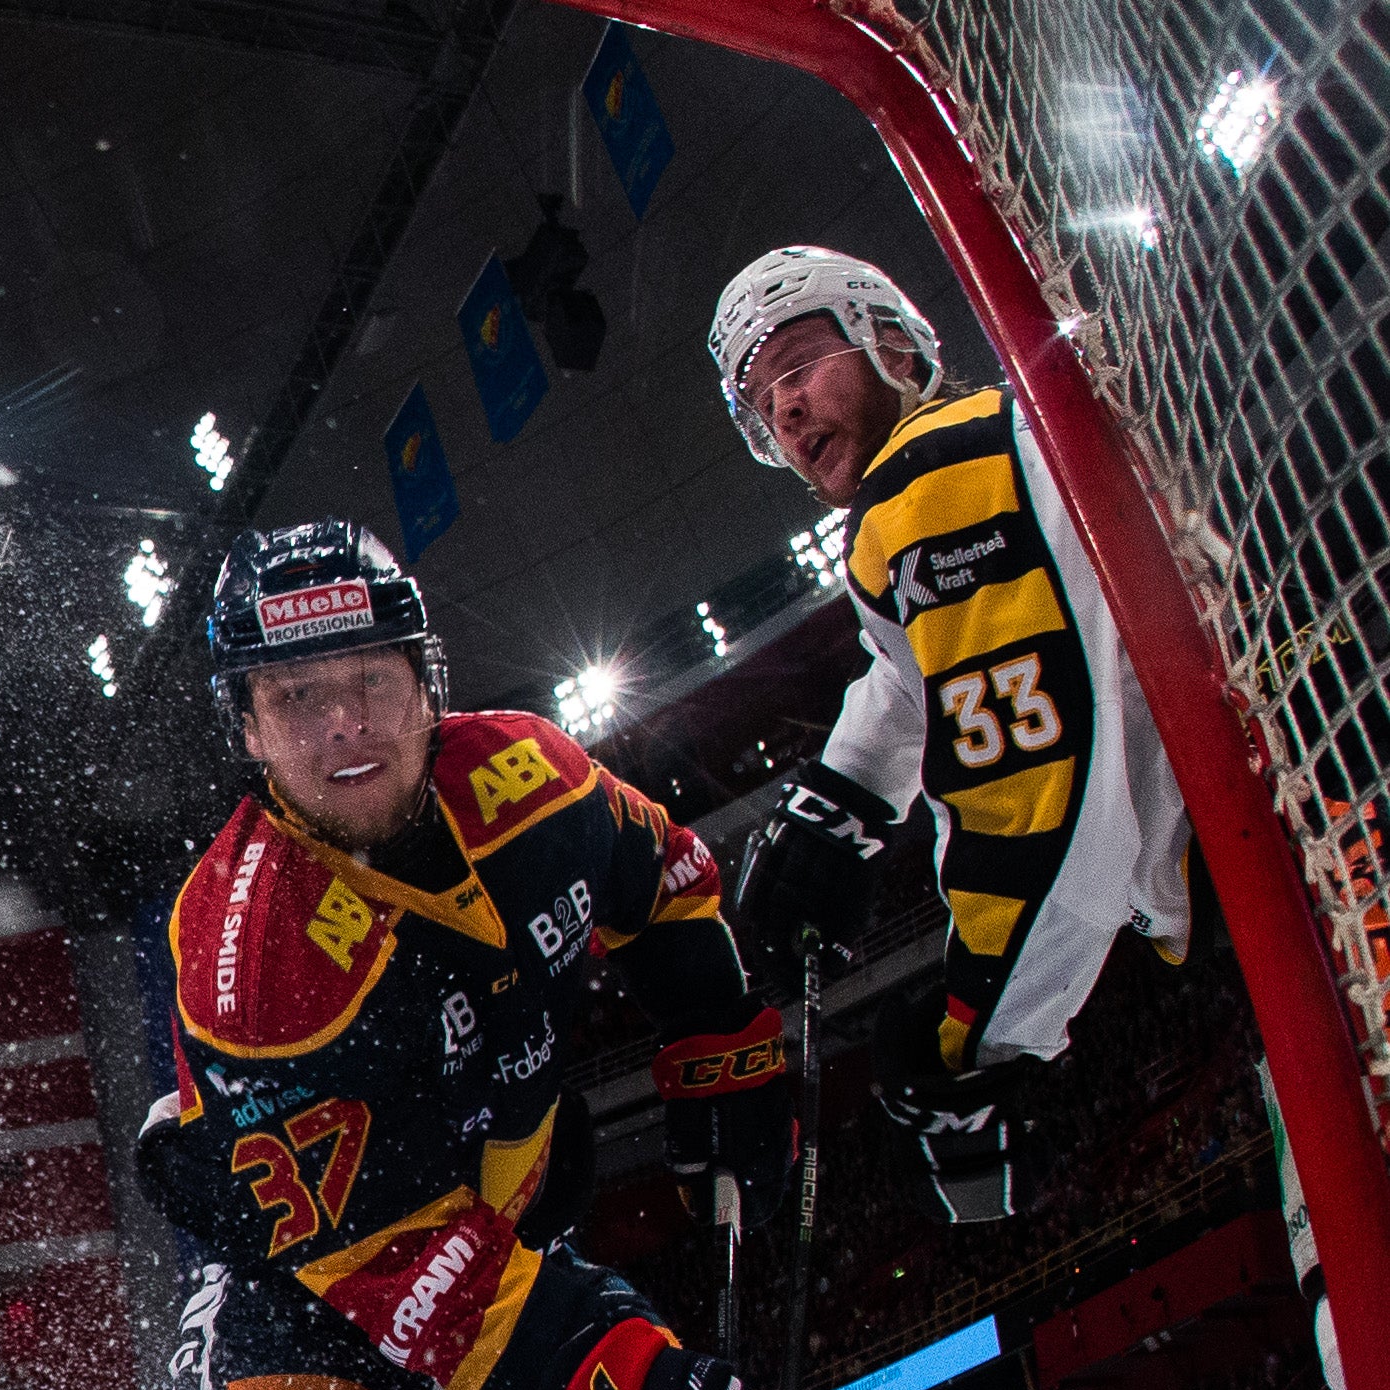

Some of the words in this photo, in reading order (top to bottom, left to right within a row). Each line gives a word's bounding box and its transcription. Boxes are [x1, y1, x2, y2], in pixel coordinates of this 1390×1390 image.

[929, 530, 1007, 572] Skellefteå
[935, 568, 976, 593] Kraft
[263, 589, 365, 625] Miele
[265, 612, 374, 645] PROFESSIONAL
[938, 651, 1063, 769] 33
[228, 841, 267, 911] BTM
[528, 879, 592, 959] B2B
[216, 913, 241, 1015] SMIDE
[230, 1097, 373, 1260] 37
